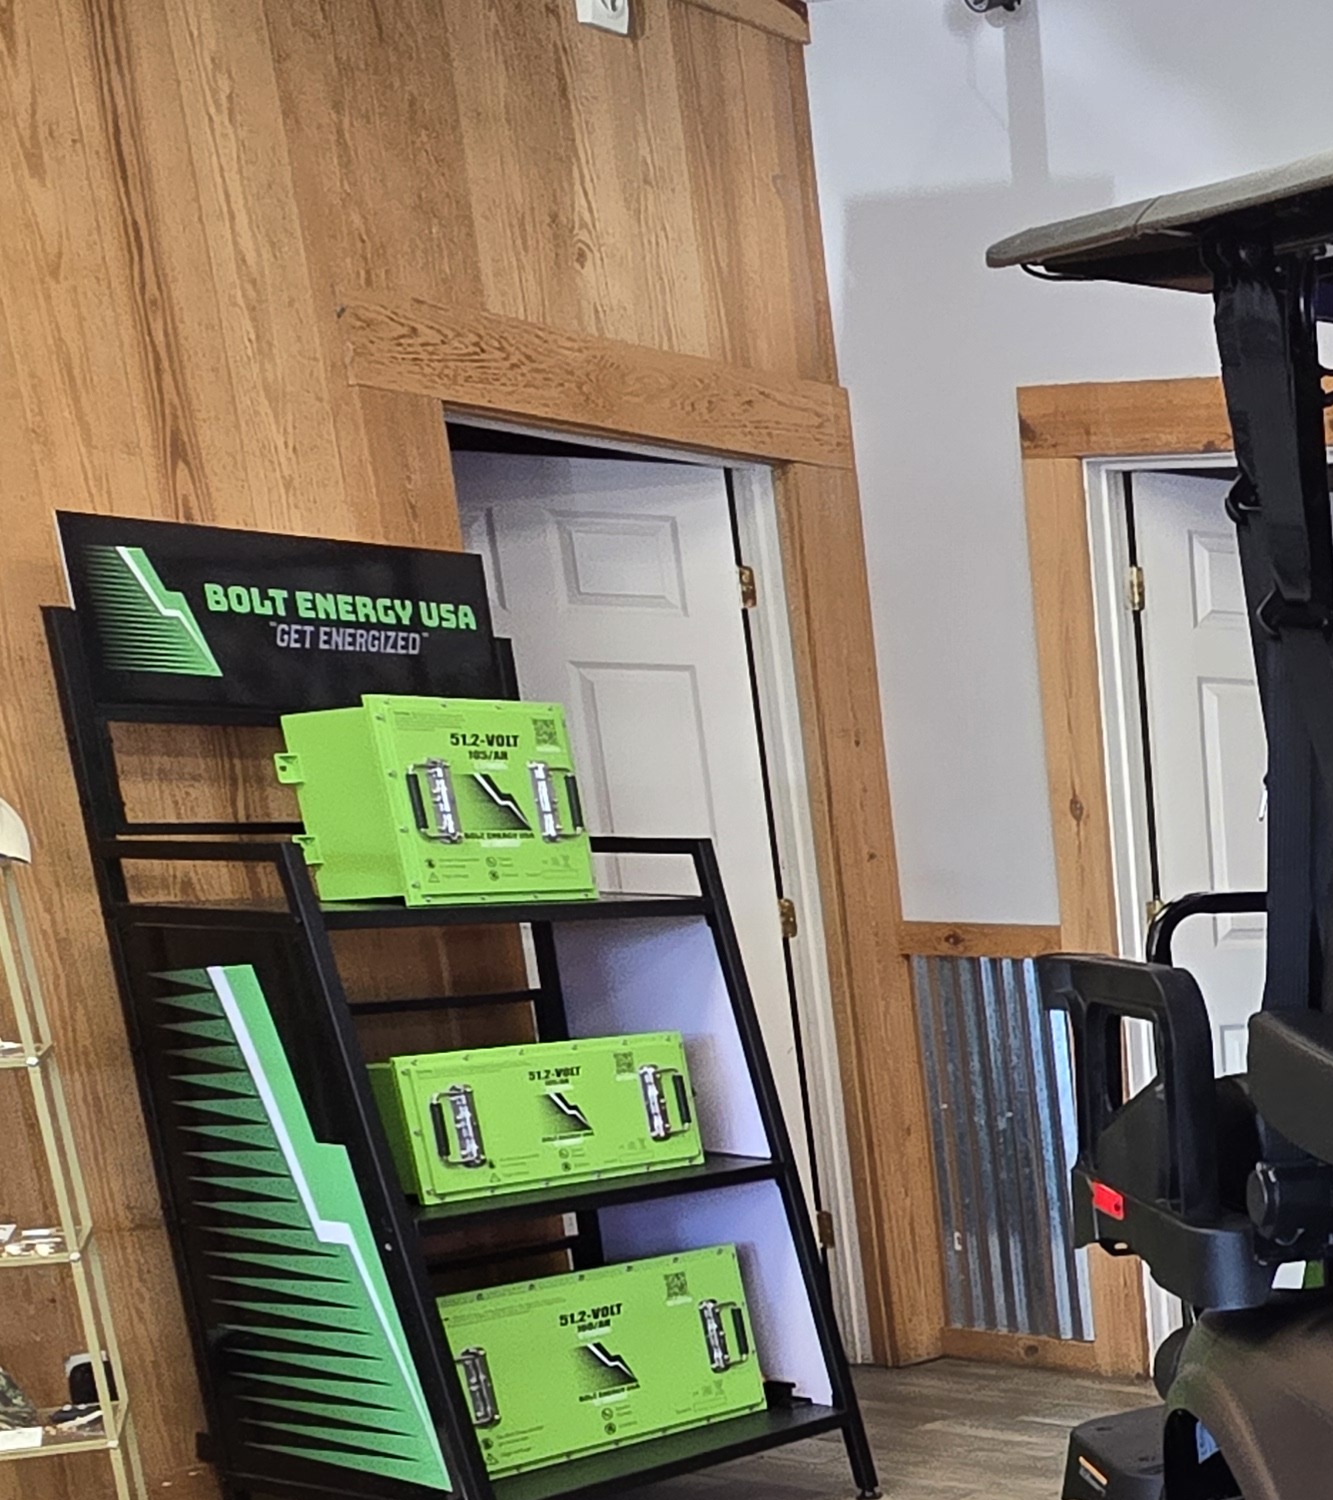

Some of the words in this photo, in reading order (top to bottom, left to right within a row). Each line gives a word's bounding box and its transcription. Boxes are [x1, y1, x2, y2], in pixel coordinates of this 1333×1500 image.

[203, 582, 288, 617] BOLT
[295, 590, 413, 626] ENERGY
[418, 599, 478, 631] USA
[449, 732, 520, 749] 51.2-VOLT
[528, 1066, 582, 1081] 51.2-VOLT
[558, 1302, 623, 1327] 51.2-VOLT
